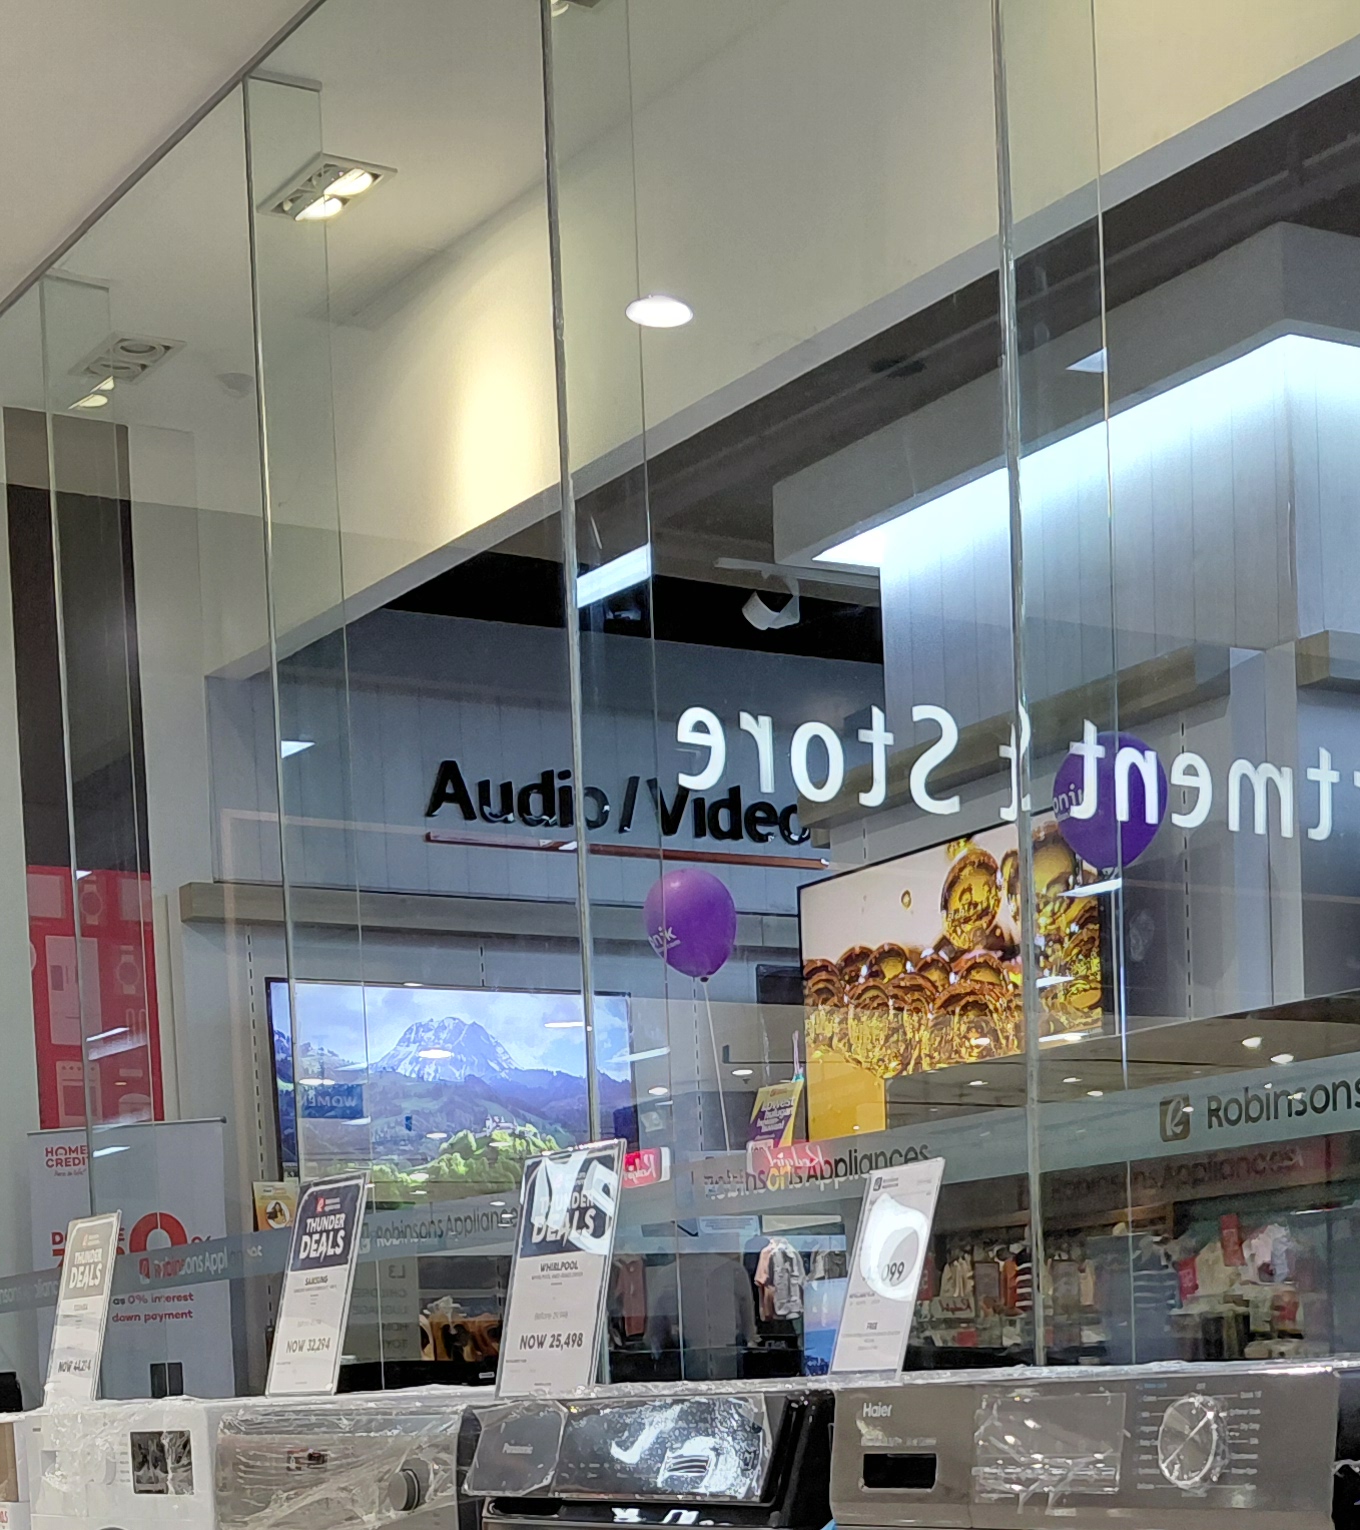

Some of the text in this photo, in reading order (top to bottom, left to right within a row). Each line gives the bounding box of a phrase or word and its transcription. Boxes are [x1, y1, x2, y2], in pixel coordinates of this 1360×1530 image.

[306, 1212, 346, 1234] THUNDER
[299, 1228, 346, 1264] DEALS
[539, 1259, 579, 1273] WHIRLPOOL
[68, 1262, 103, 1292] DEALS
[285, 1338, 305, 1354] NOW
[519, 1331, 584, 1352] NOW 25,498
[862, 1402, 893, 1418] Haier
